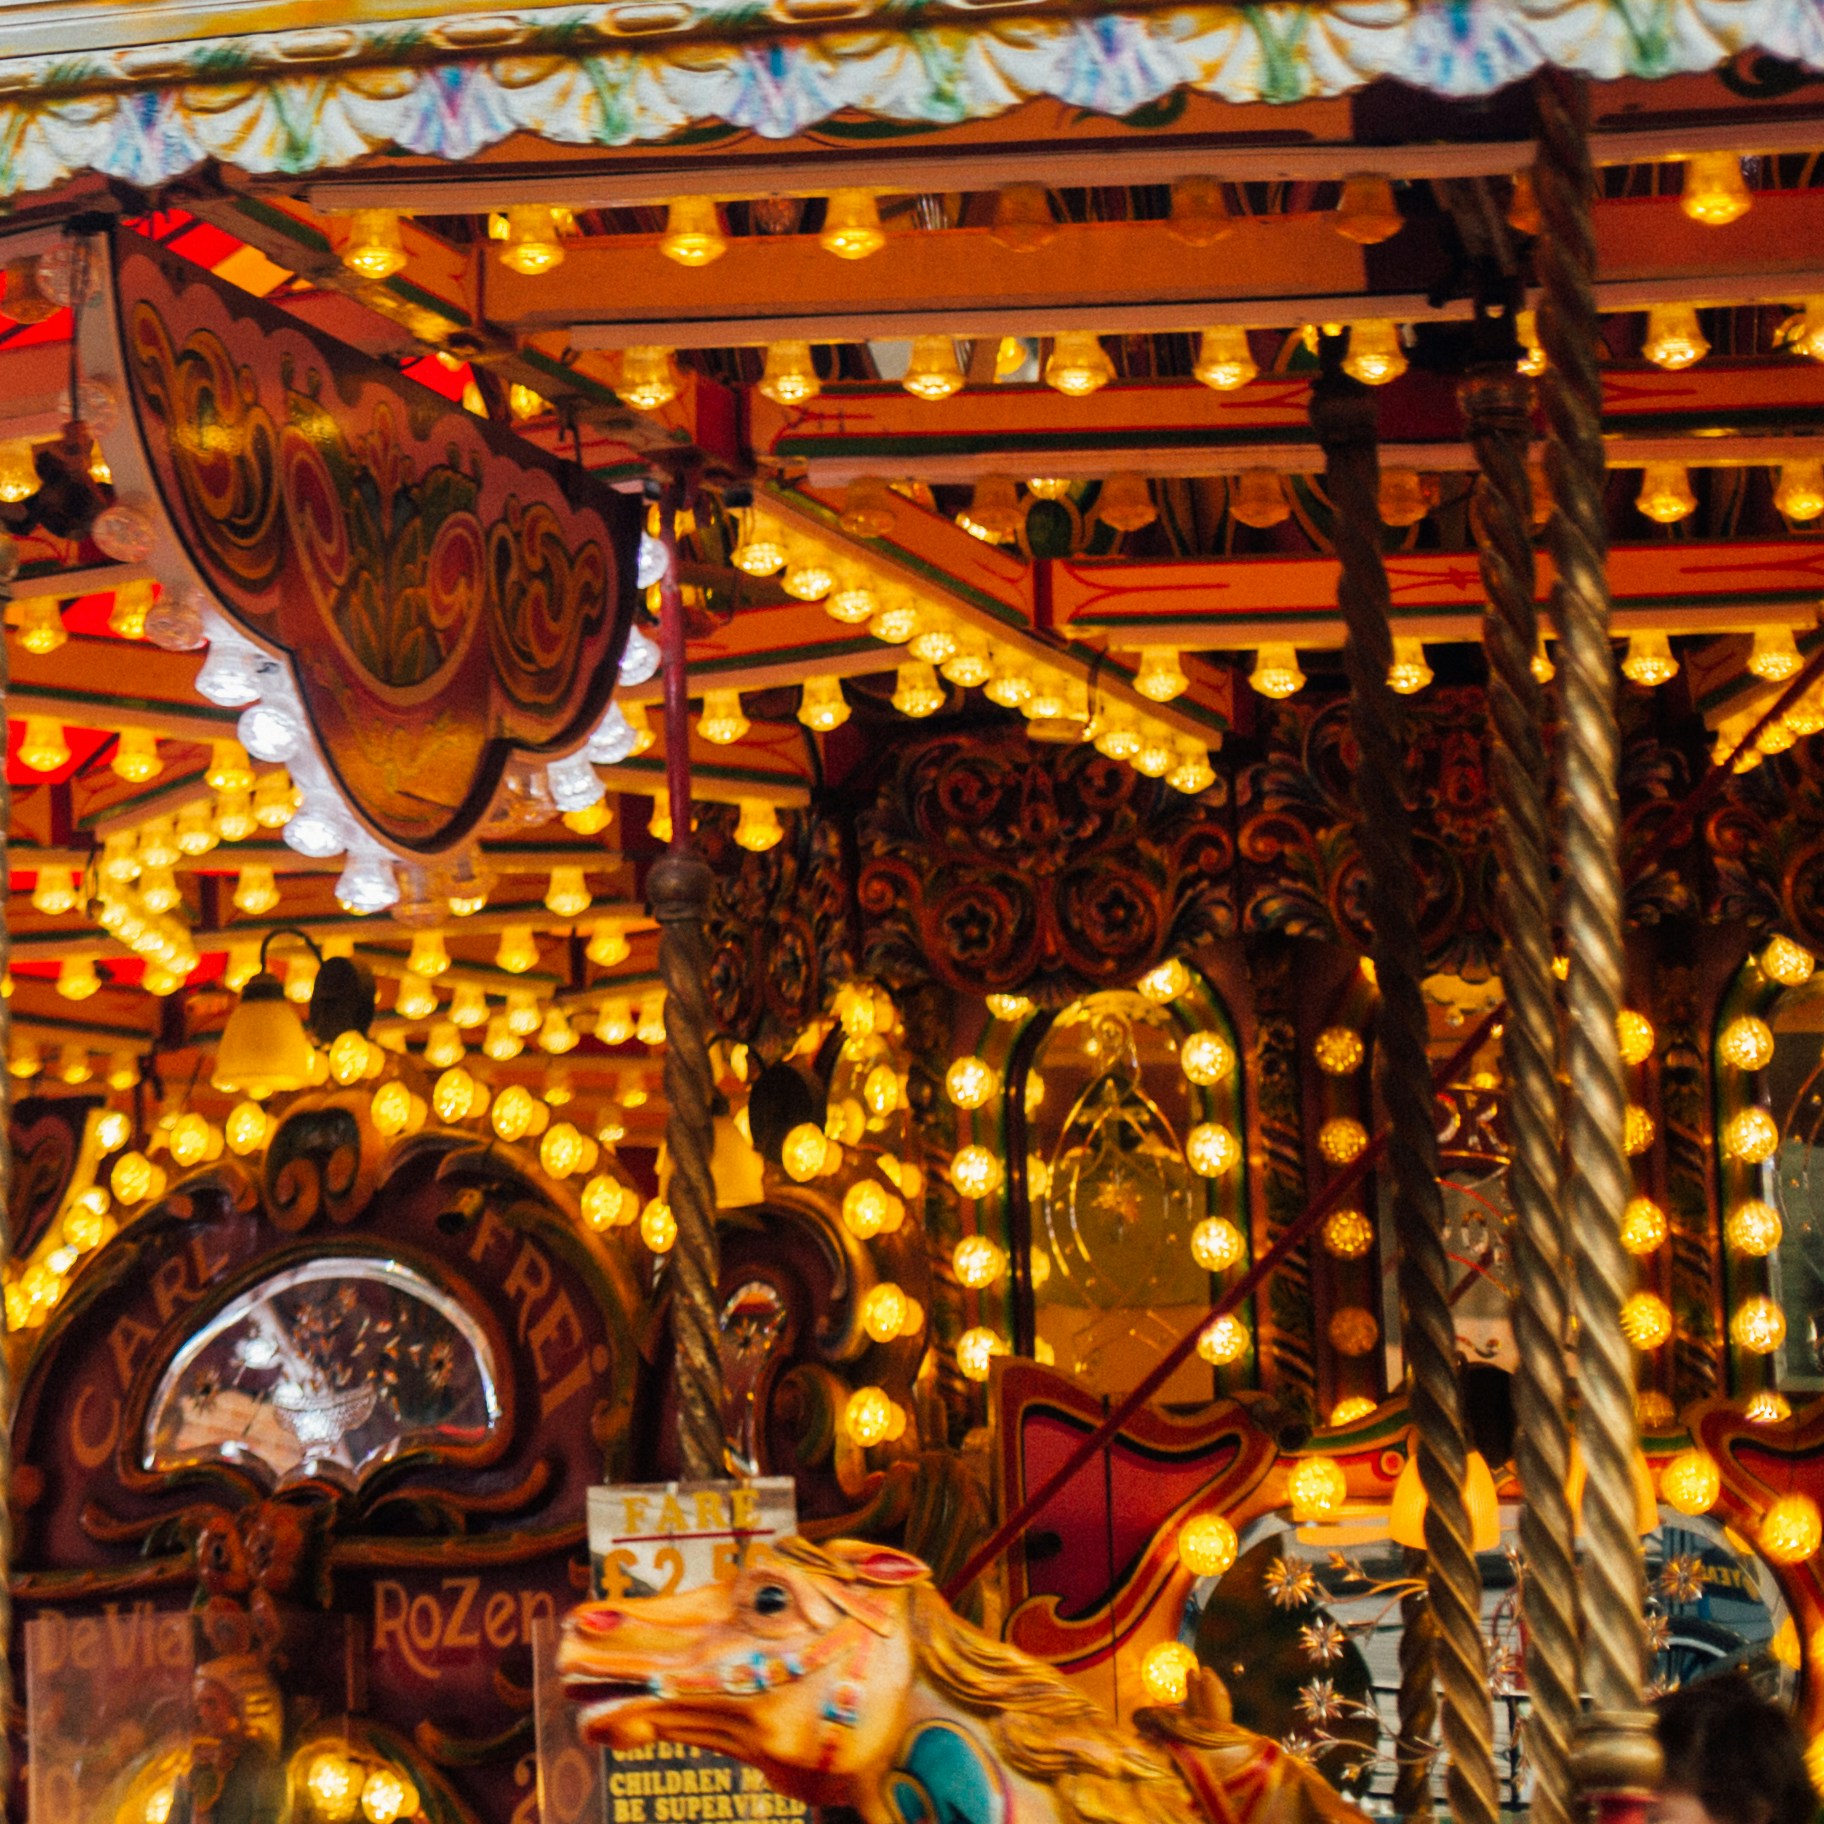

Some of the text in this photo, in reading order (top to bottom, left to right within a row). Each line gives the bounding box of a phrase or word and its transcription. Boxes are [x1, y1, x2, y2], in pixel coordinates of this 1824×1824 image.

[70, 1234, 230, 1468] CARL
[621, 1488, 761, 1534] FARE
[372, 1576, 556, 1680] RoZen
[609, 1767, 733, 1797] CHILDREN
[613, 1792, 807, 1823] BE SUPERVISED
